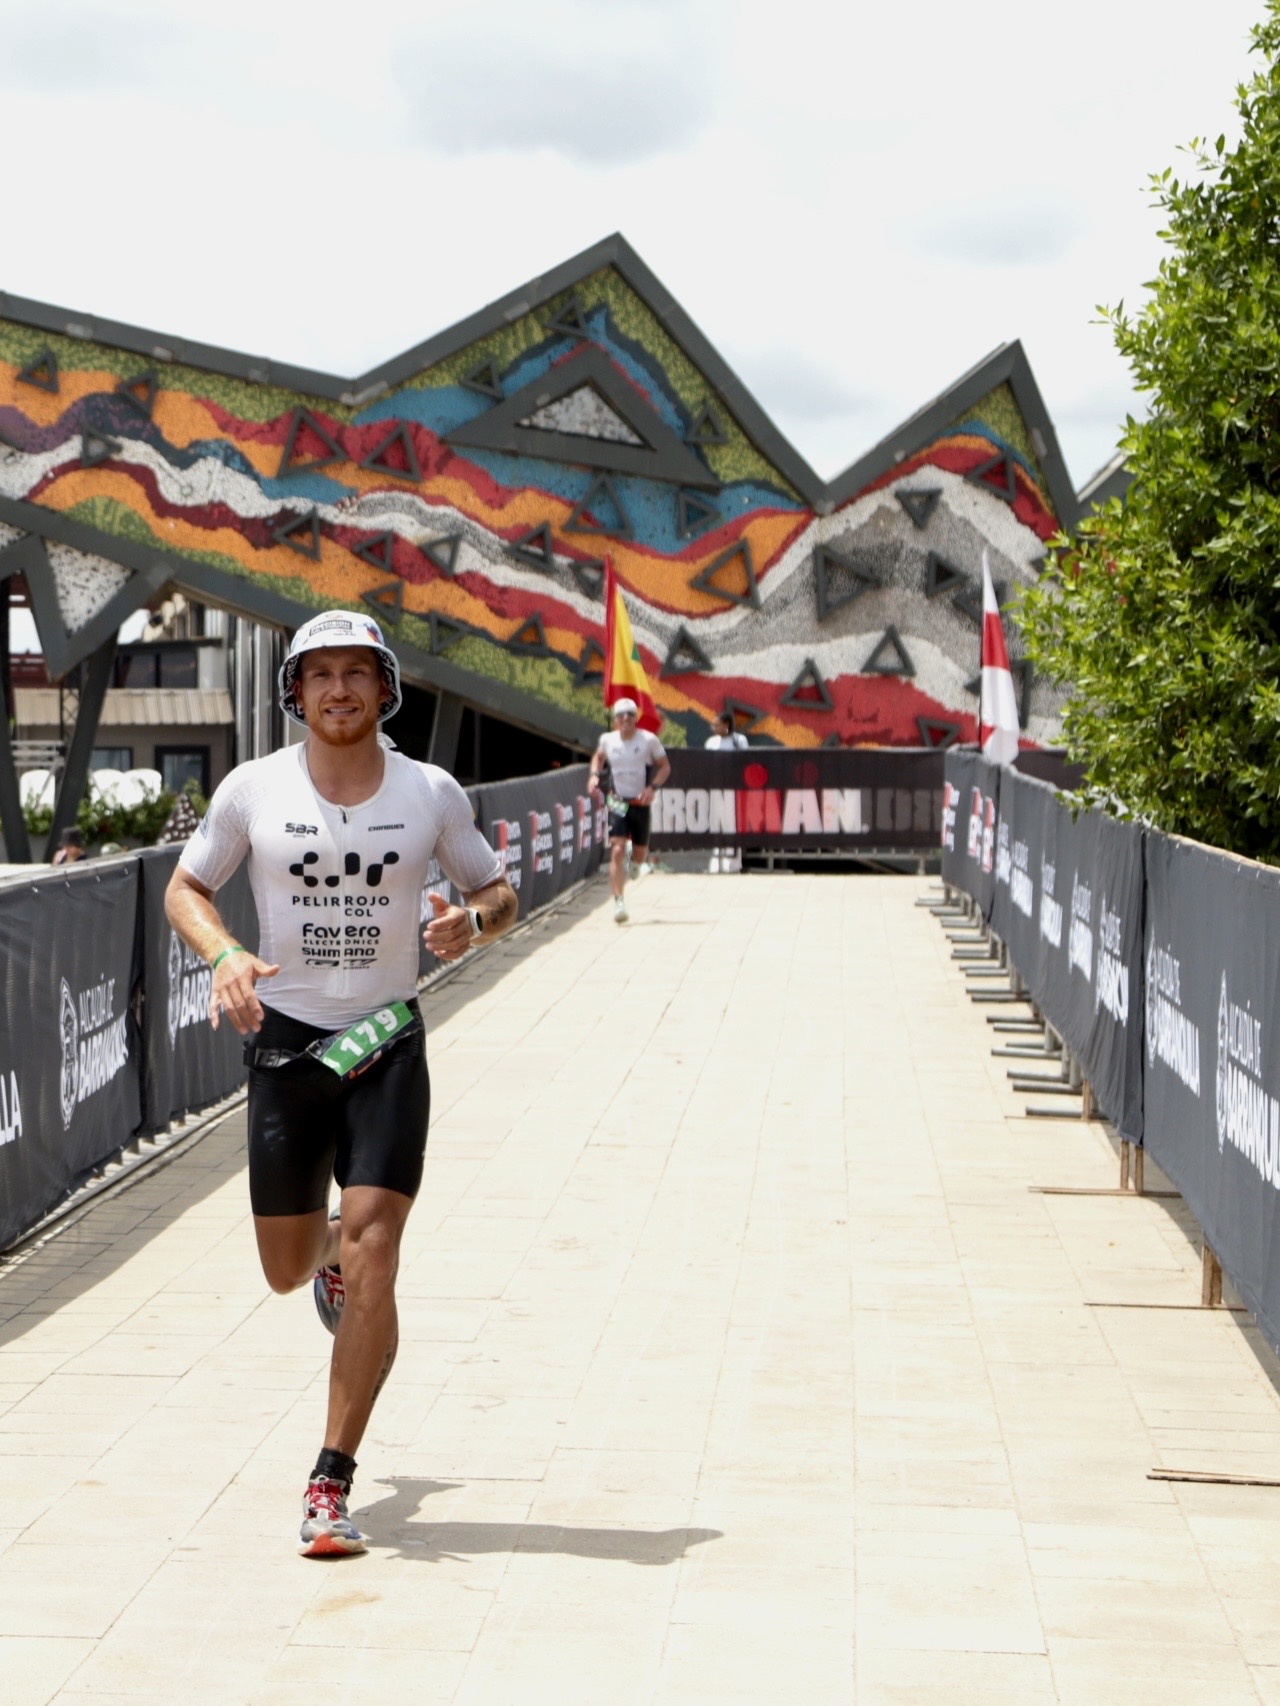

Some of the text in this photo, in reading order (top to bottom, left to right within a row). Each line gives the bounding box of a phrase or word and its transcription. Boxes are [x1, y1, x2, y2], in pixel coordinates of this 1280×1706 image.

[652, 763, 863, 834] IRONMAN
[285, 822, 318, 836] SBR
[292, 895, 390, 907] PELIRROJO
[344, 908, 373, 917] COL
[302, 922, 381, 938] Favero
[302, 947, 375, 957] SHIMANO
